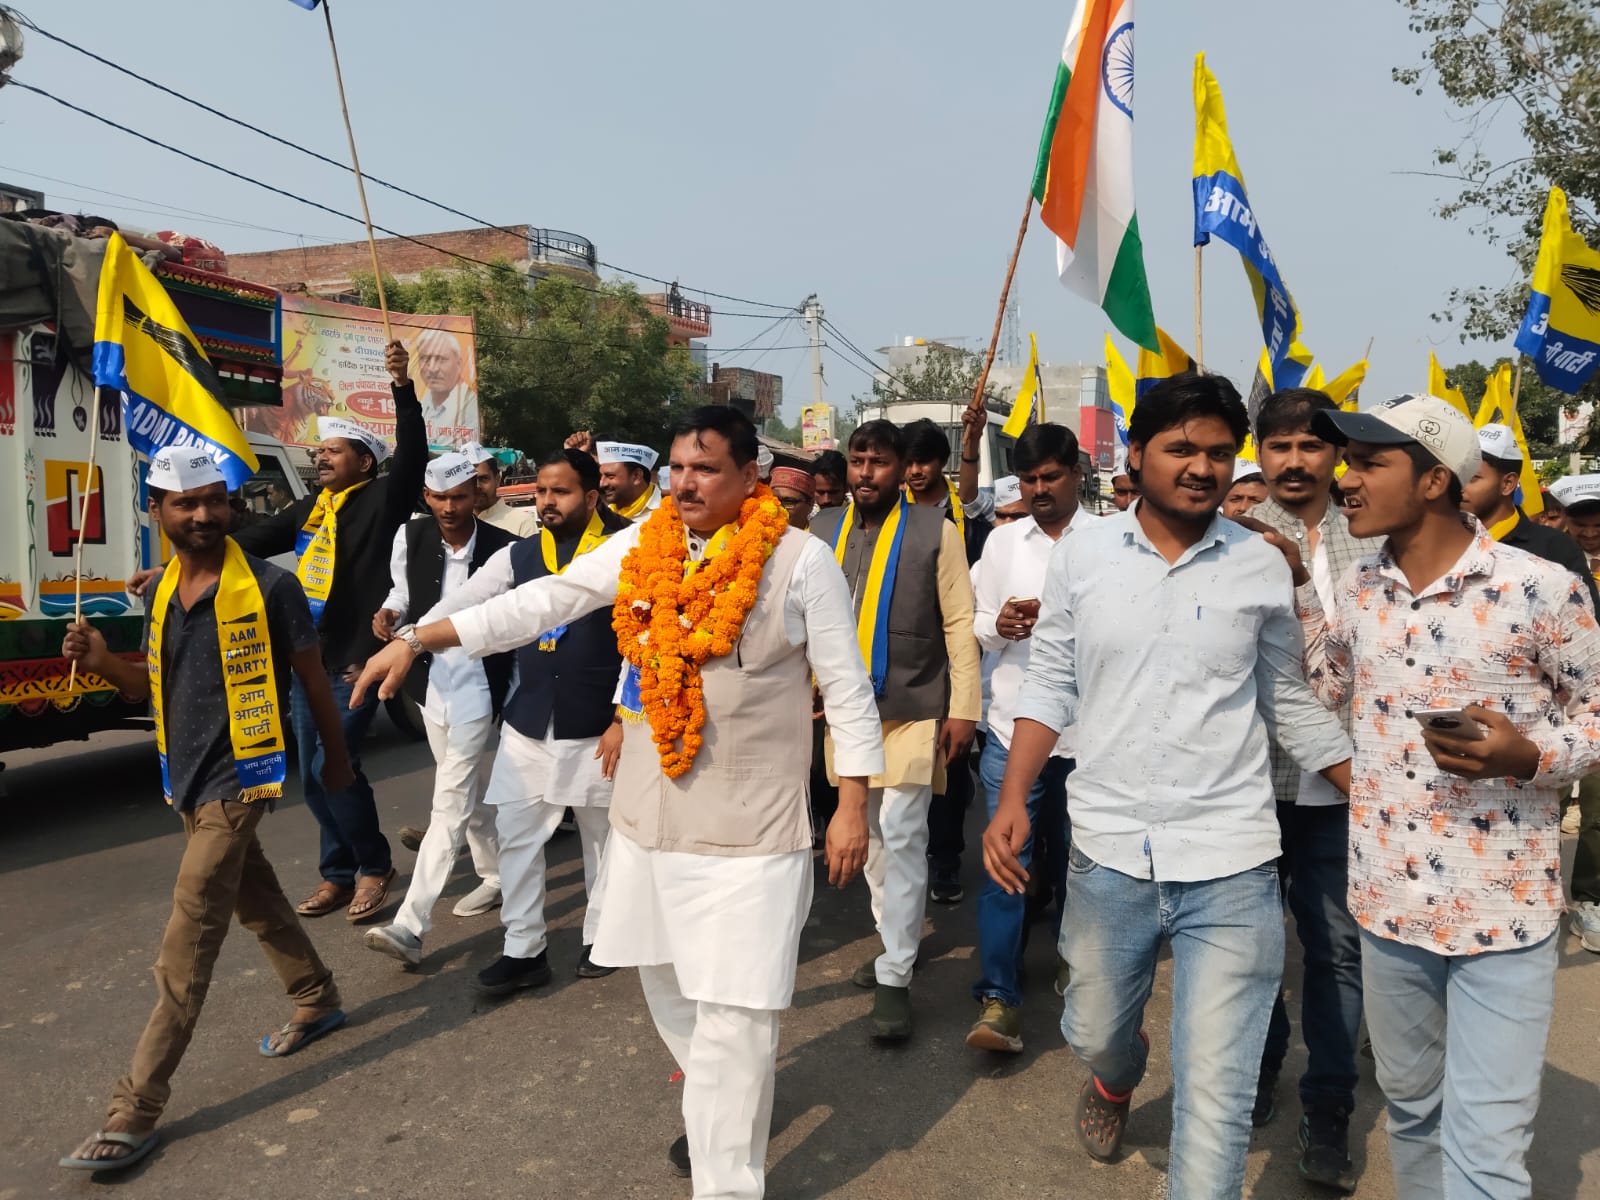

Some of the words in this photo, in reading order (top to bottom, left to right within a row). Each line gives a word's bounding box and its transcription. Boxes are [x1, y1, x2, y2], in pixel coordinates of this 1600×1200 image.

[1204, 186, 1256, 238] आम
[1553, 350, 1597, 374] पार्टी
[603, 446, 620, 454] आम
[189, 456, 210, 470] आम
[444, 464, 463, 479] आम
[230, 627, 257, 643] AAM
[226, 641, 266, 660] AADMI
[227, 658, 268, 676] PARTY
[239, 689, 265, 704] आम
[234, 700, 274, 721] आदमी
[242, 718, 271, 737] पार्टी
